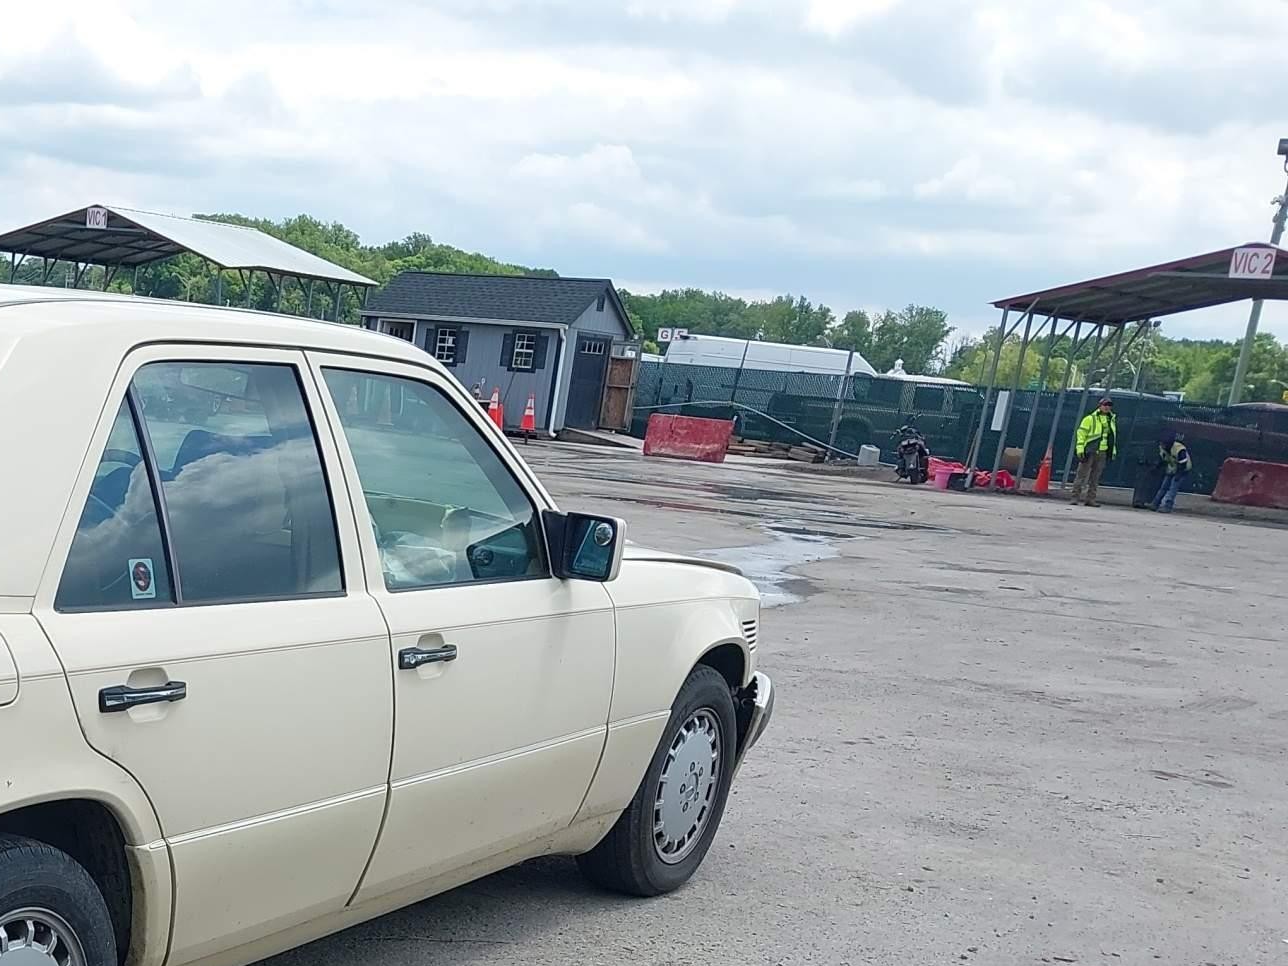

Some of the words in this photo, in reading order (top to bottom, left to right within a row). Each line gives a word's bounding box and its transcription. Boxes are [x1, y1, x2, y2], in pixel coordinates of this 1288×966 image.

[88, 210, 101, 226] VIC
[1233, 252, 1260, 274] VIC
[1261, 252, 1274, 274] 2
[660, 330, 670, 340] G
